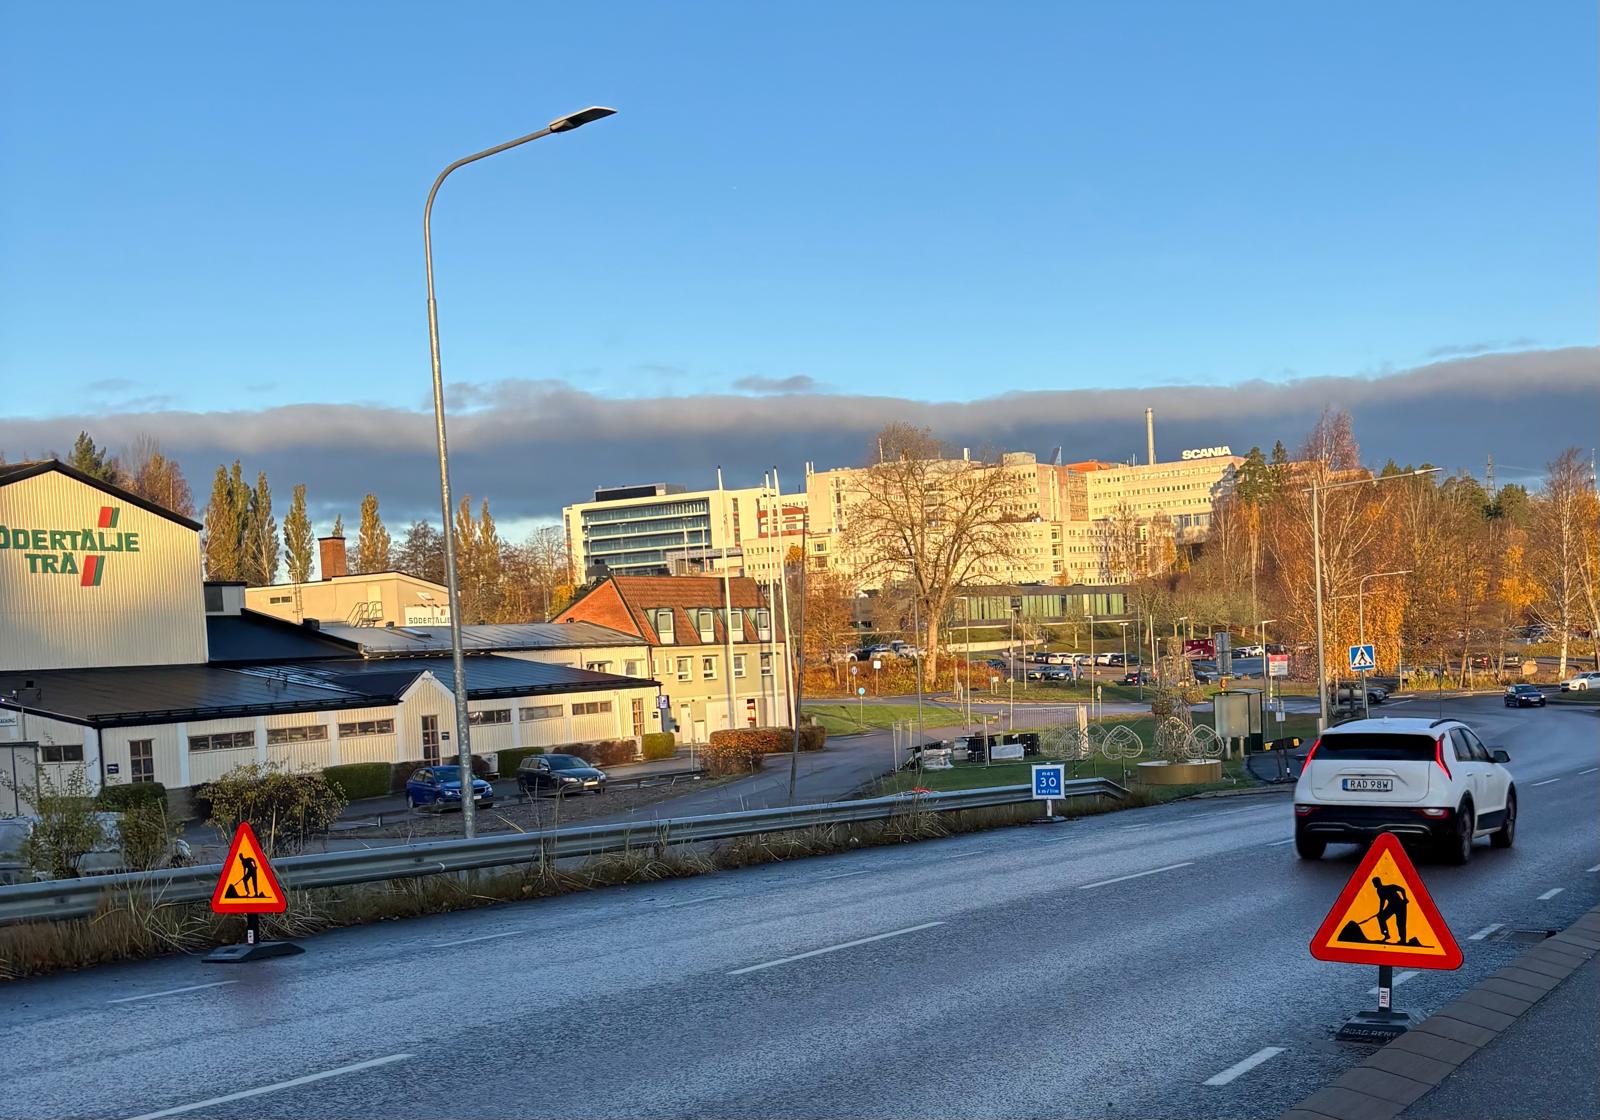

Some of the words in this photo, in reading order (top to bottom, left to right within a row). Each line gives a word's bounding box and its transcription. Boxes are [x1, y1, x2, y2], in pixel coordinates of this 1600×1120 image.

[1182, 446, 1232, 460] SCANIA
[24, 552, 79, 574] TRÄ
[1040, 777, 1057, 787] 30
[1350, 780, 1368, 789] RAD
[1370, 780, 1389, 789] 98W
